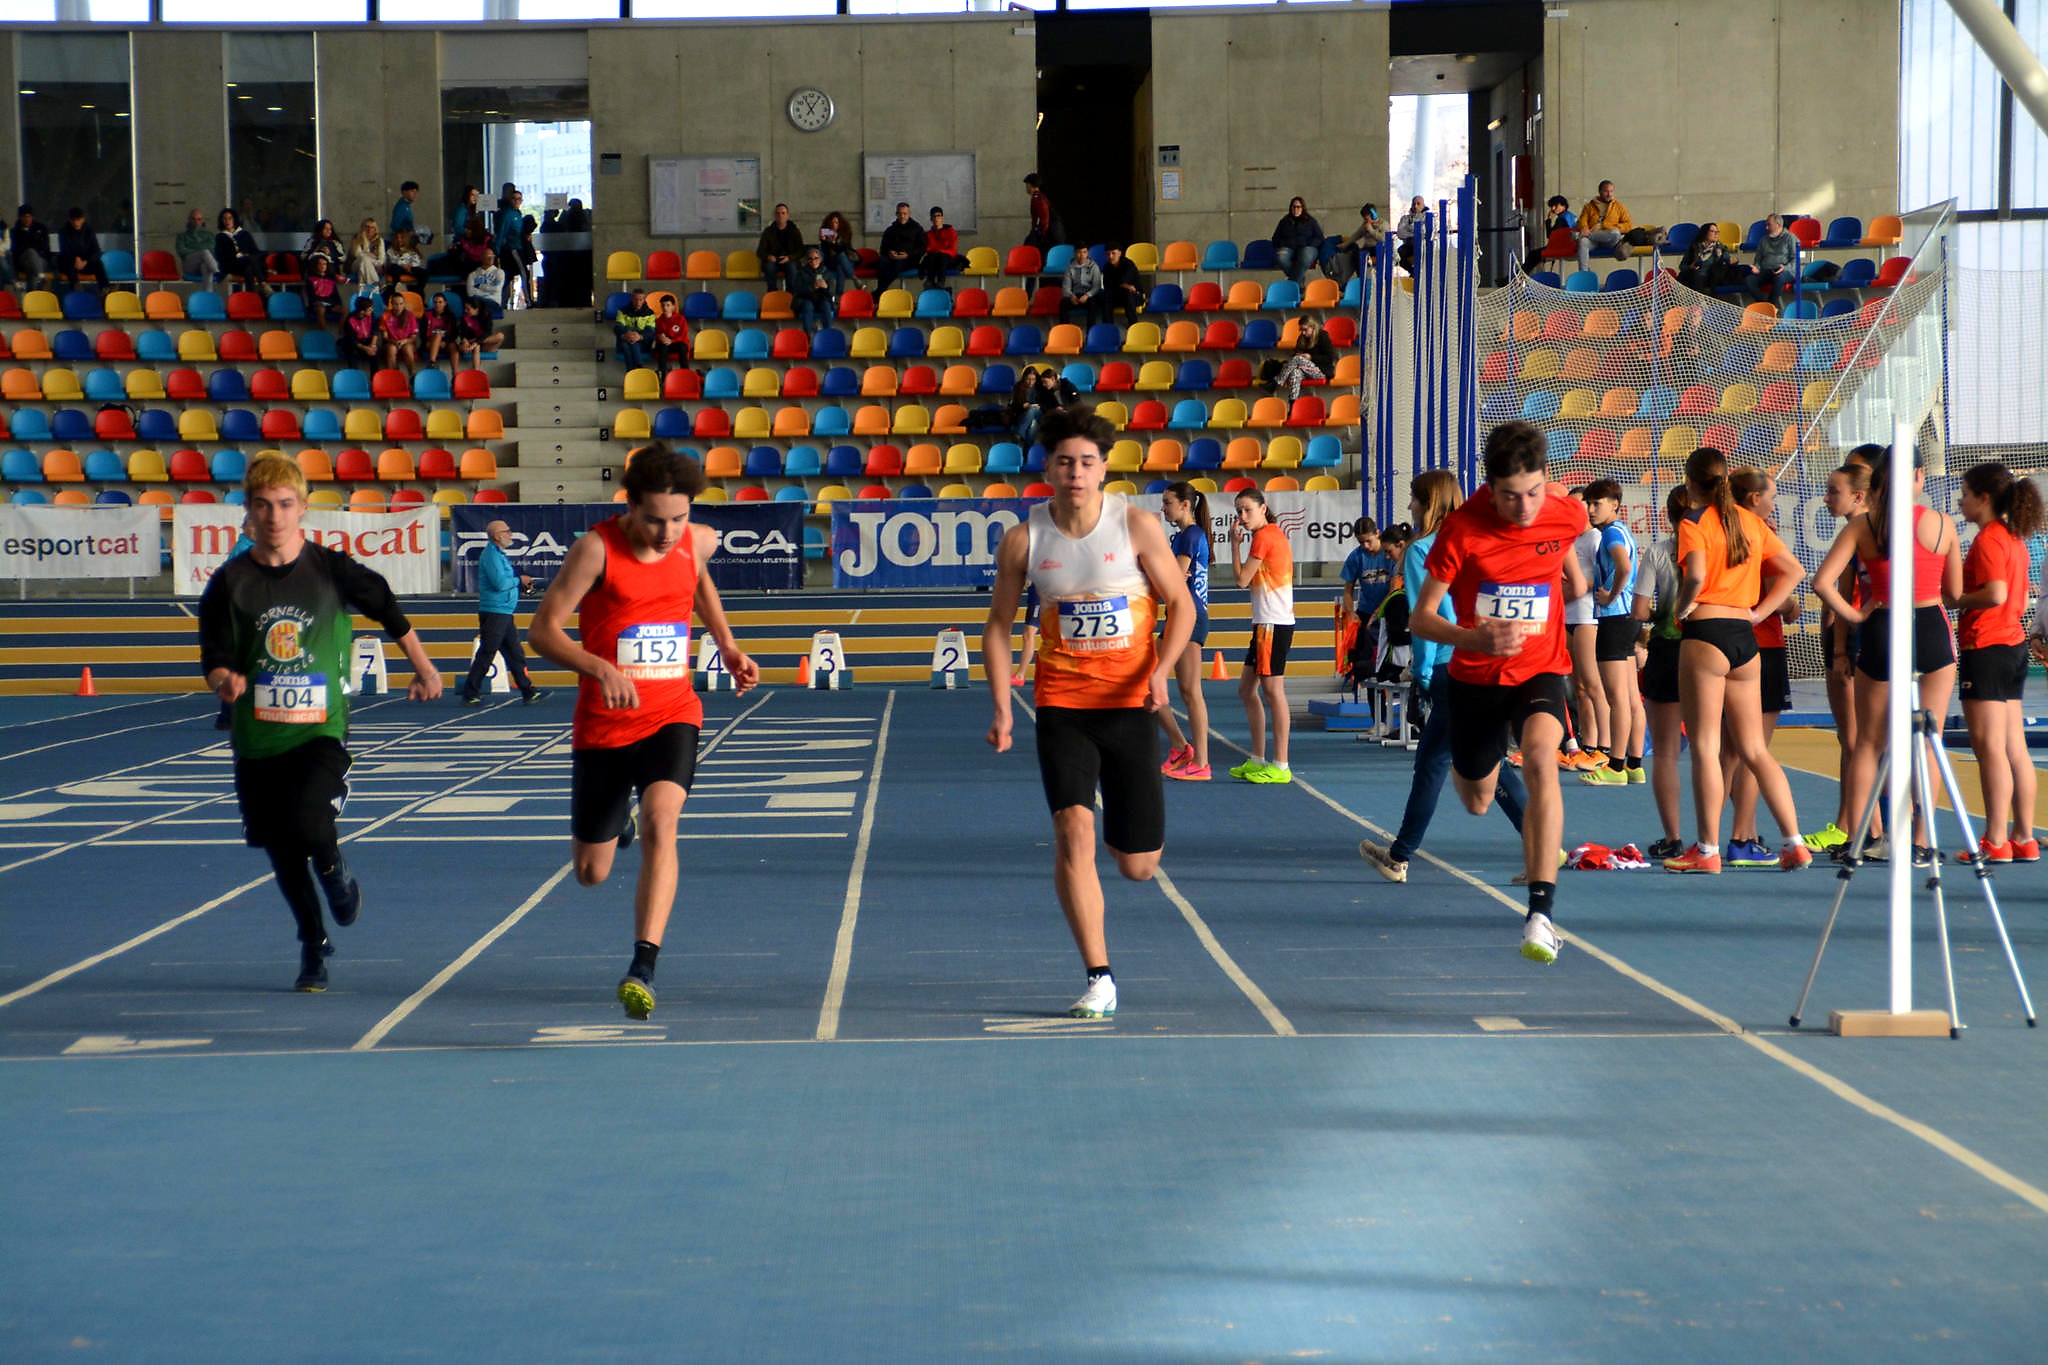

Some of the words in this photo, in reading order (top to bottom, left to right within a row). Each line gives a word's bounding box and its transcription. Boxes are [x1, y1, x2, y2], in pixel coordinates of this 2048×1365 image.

[4, 533, 139, 561] esportcat
[1489, 598, 1535, 620] 151
[1072, 615, 1119, 638] 273
[632, 640, 678, 663] 152
[706, 650, 724, 673] 4
[818, 648, 836, 674] 3
[941, 647, 959, 673] 2
[268, 688, 313, 708] 104
[259, 711, 320, 722] mutuacat
